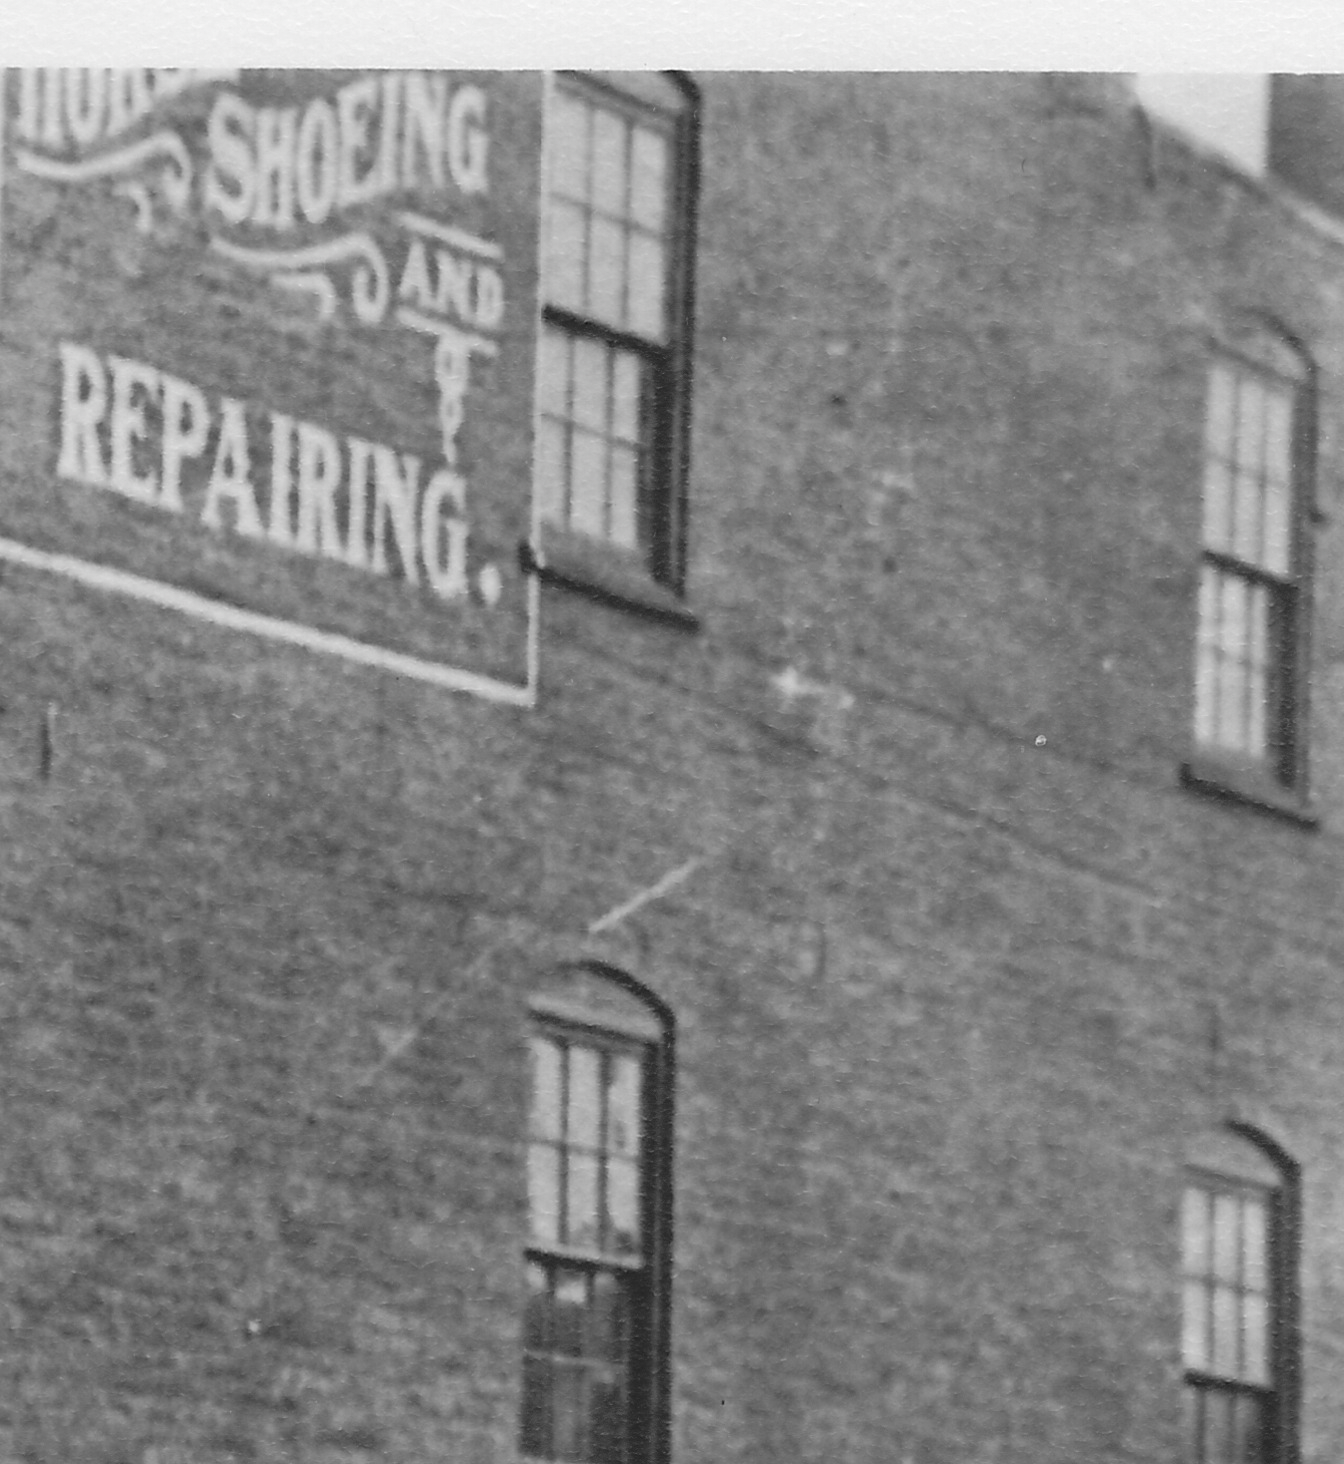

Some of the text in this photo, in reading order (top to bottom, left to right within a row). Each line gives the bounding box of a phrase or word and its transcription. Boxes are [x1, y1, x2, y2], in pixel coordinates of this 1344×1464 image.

[203, 72, 489, 231] SHOEING
[399, 240, 505, 330] AND
[57, 343, 502, 603] REPAIRING.
